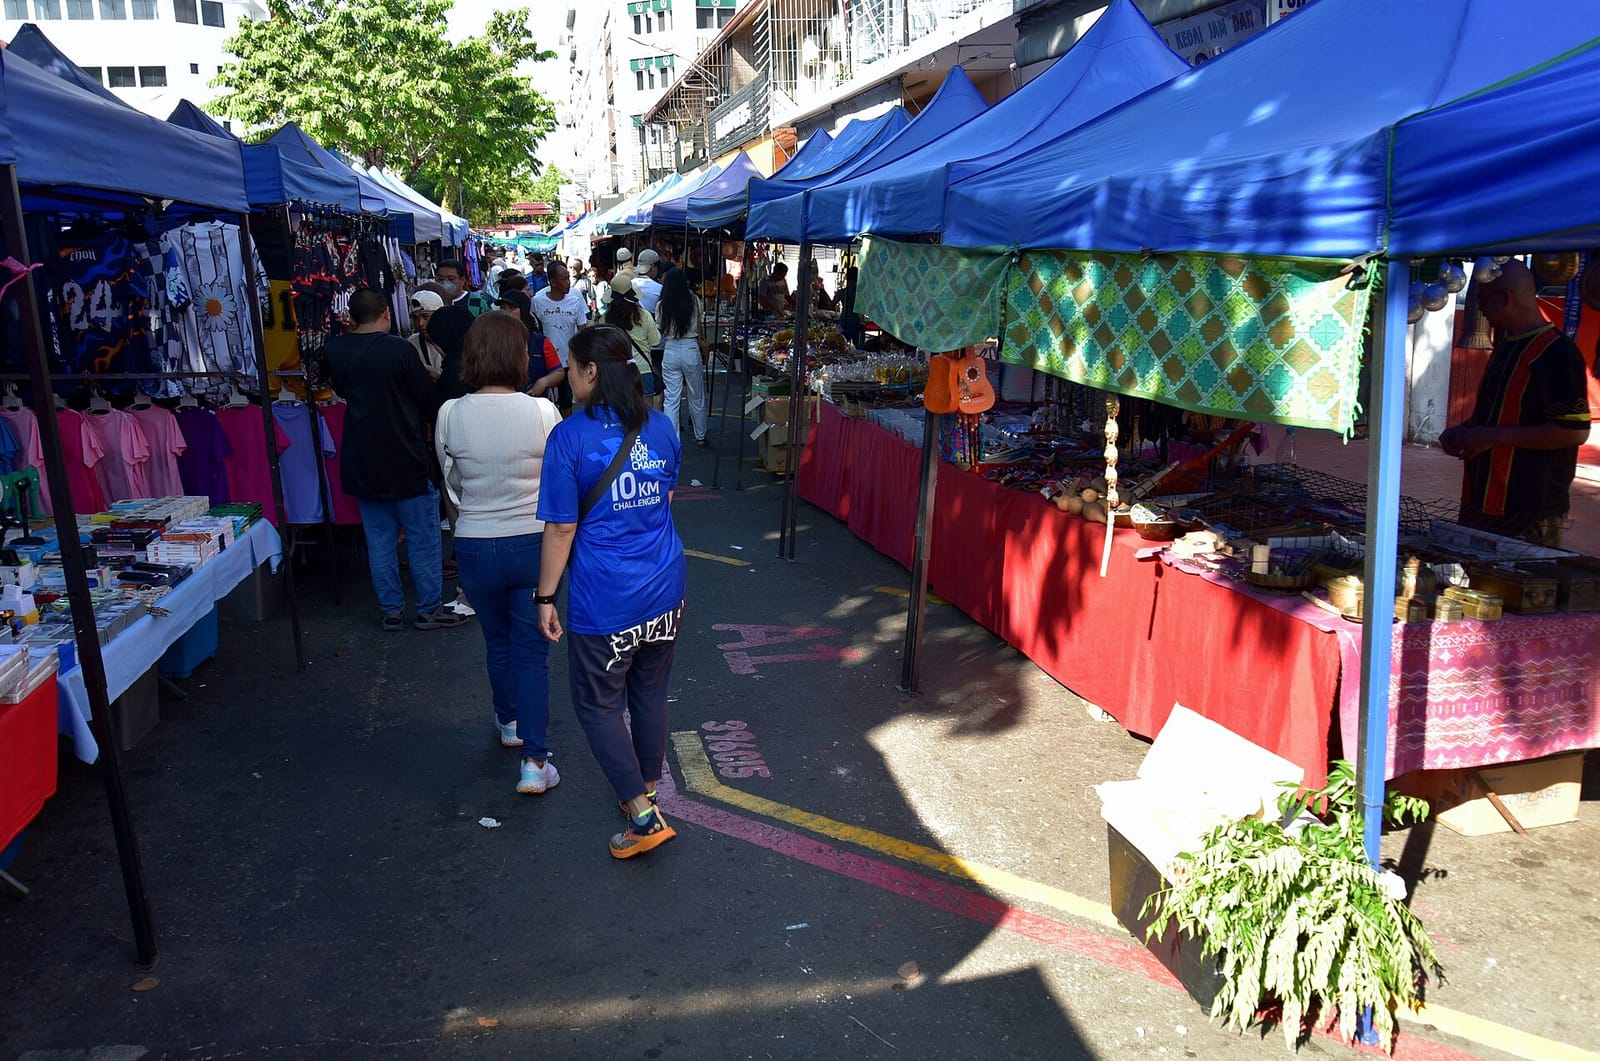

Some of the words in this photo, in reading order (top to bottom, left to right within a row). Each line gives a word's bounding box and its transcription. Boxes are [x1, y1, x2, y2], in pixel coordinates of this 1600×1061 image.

[1175, 26, 1204, 49] KEDAI
[1208, 18, 1228, 40] JAM
[1232, 9, 1255, 33] DAN
[62, 279, 122, 333] 24
[630, 452, 649, 462] FOR
[631, 459, 667, 471] CHARITY
[611, 471, 636, 501] 10
[638, 481, 660, 497] KM
[612, 496, 661, 511] CHALLENGER
